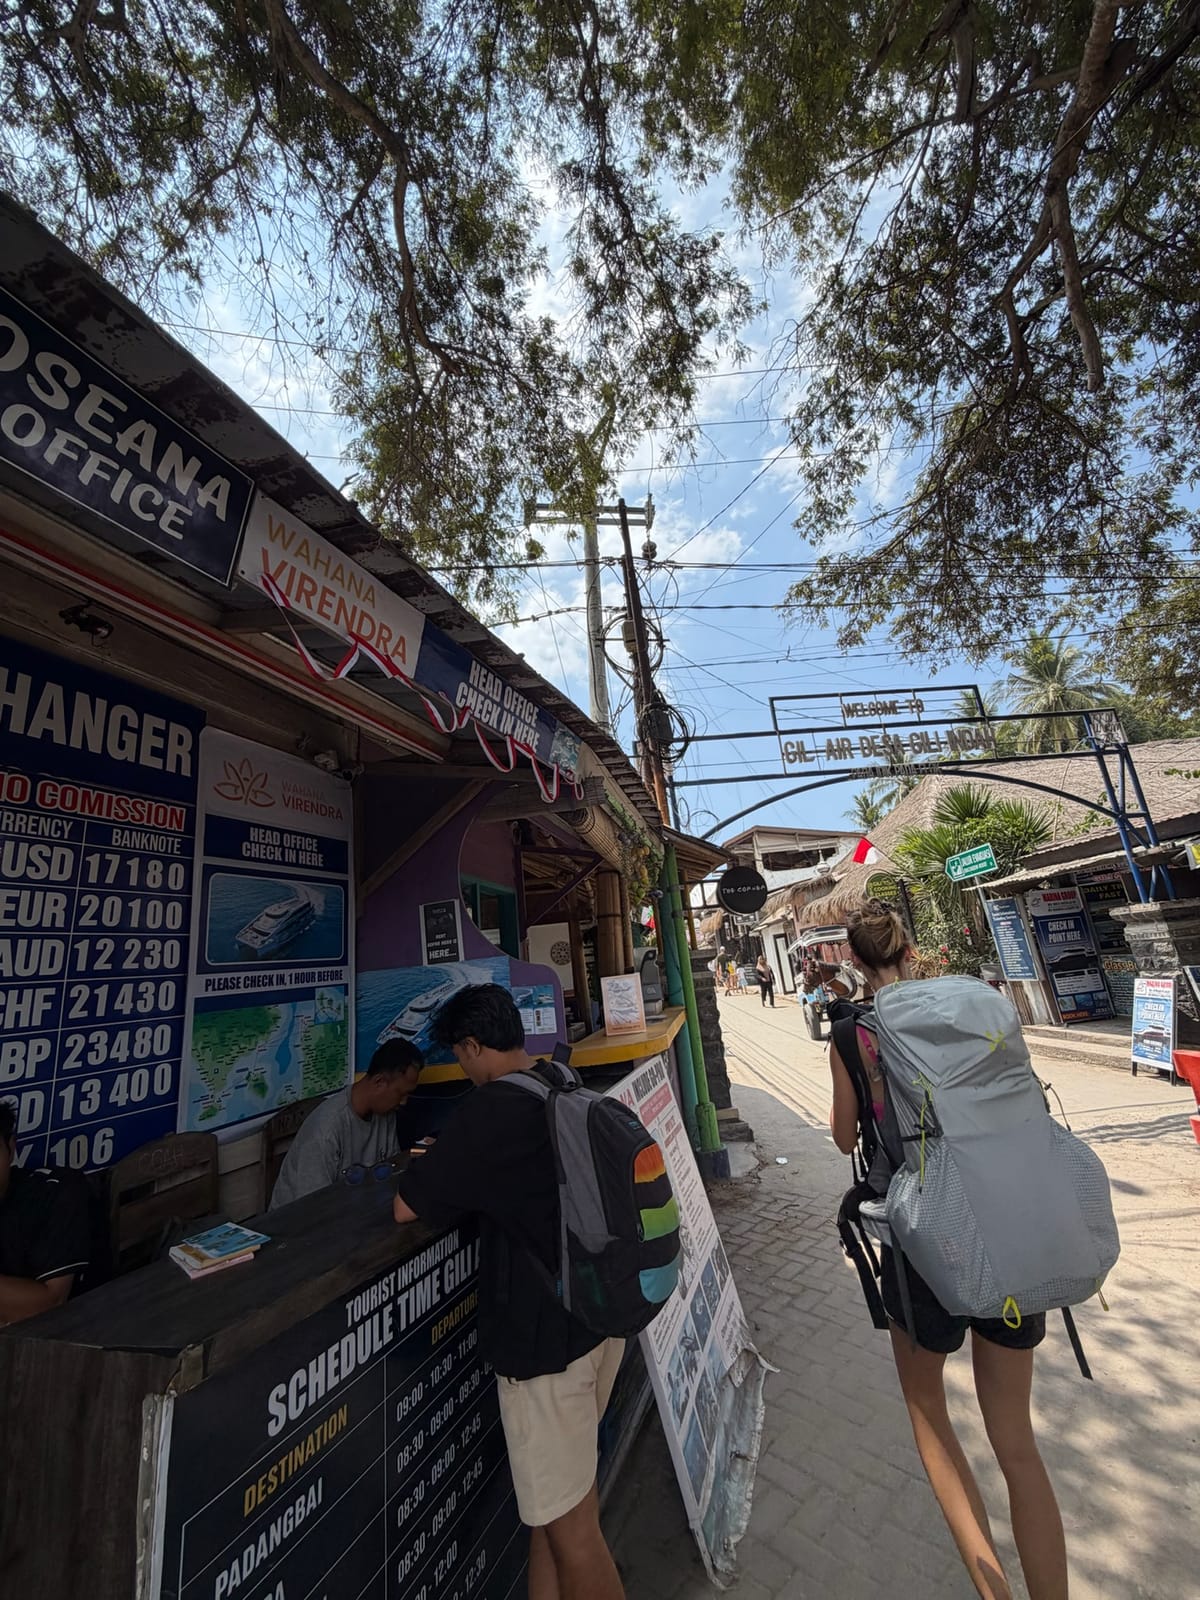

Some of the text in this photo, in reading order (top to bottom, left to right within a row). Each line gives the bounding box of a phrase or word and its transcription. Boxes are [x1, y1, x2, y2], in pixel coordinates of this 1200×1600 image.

[0, 403, 193, 540] OFFICE
[268, 514, 376, 608] WAHANA
[261, 547, 407, 665] VIRENDRA
[455, 682, 540, 753] CHECK IN HERE
[469, 660, 540, 728] HEAD OFFICE
[842, 698, 925, 719] WELCOME TO
[0, 666, 193, 777] HANGER
[825, 736, 855, 762] AIR
[859, 734, 905, 758] DESA
[908, 731, 943, 755] GILI
[37, 780, 186, 832] COMISSION
[282, 778, 326, 800] WAHANA
[282, 794, 343, 821] VIRENDRA
[1, 840, 74, 881] USD
[111, 828, 182, 855] BANKNOTE
[242, 841, 324, 867] CHECK IN HERE
[250, 826, 318, 852] HEAD OFFICE
[0, 889, 67, 927] EUR
[205, 976, 241, 992] PLEASE
[243, 973, 274, 989] CHECK
[294, 970, 316, 984] HOUR
[317, 969, 343, 982] BEFORE
[62, 1024, 172, 1070] 23480
[51, 1127, 115, 1169] 106
[346, 1276, 394, 1328] TOURIST
[397, 1228, 459, 1292] INFORMATION
[268, 1307, 393, 1438] SCHEDULE
[397, 1268, 440, 1333] TIME
[444, 1244, 472, 1295] GILI
[397, 1382, 423, 1421] 09:00
[430, 1353, 452, 1387] 10:30
[458, 1328, 477, 1359] 11:00
[397, 1430, 424, 1473] 08:30
[431, 1397, 454, 1436] 09:00
[459, 1369, 480, 1403] 09:30
[243, 1404, 347, 1517] DESTINATION
[397, 1480, 425, 1527] 08:30
[431, 1443, 456, 1486] 09:00
[461, 1412, 481, 1448] 12:45
[214, 1476, 323, 1600] PADANGBAI
[398, 1532, 426, 1583] 08:30
[432, 1491, 457, 1537] 09:00
[462, 1456, 483, 1495] 12:45
[434, 1540, 457, 1587] 12:00
[465, 1549, 486, 1593] 12:30
